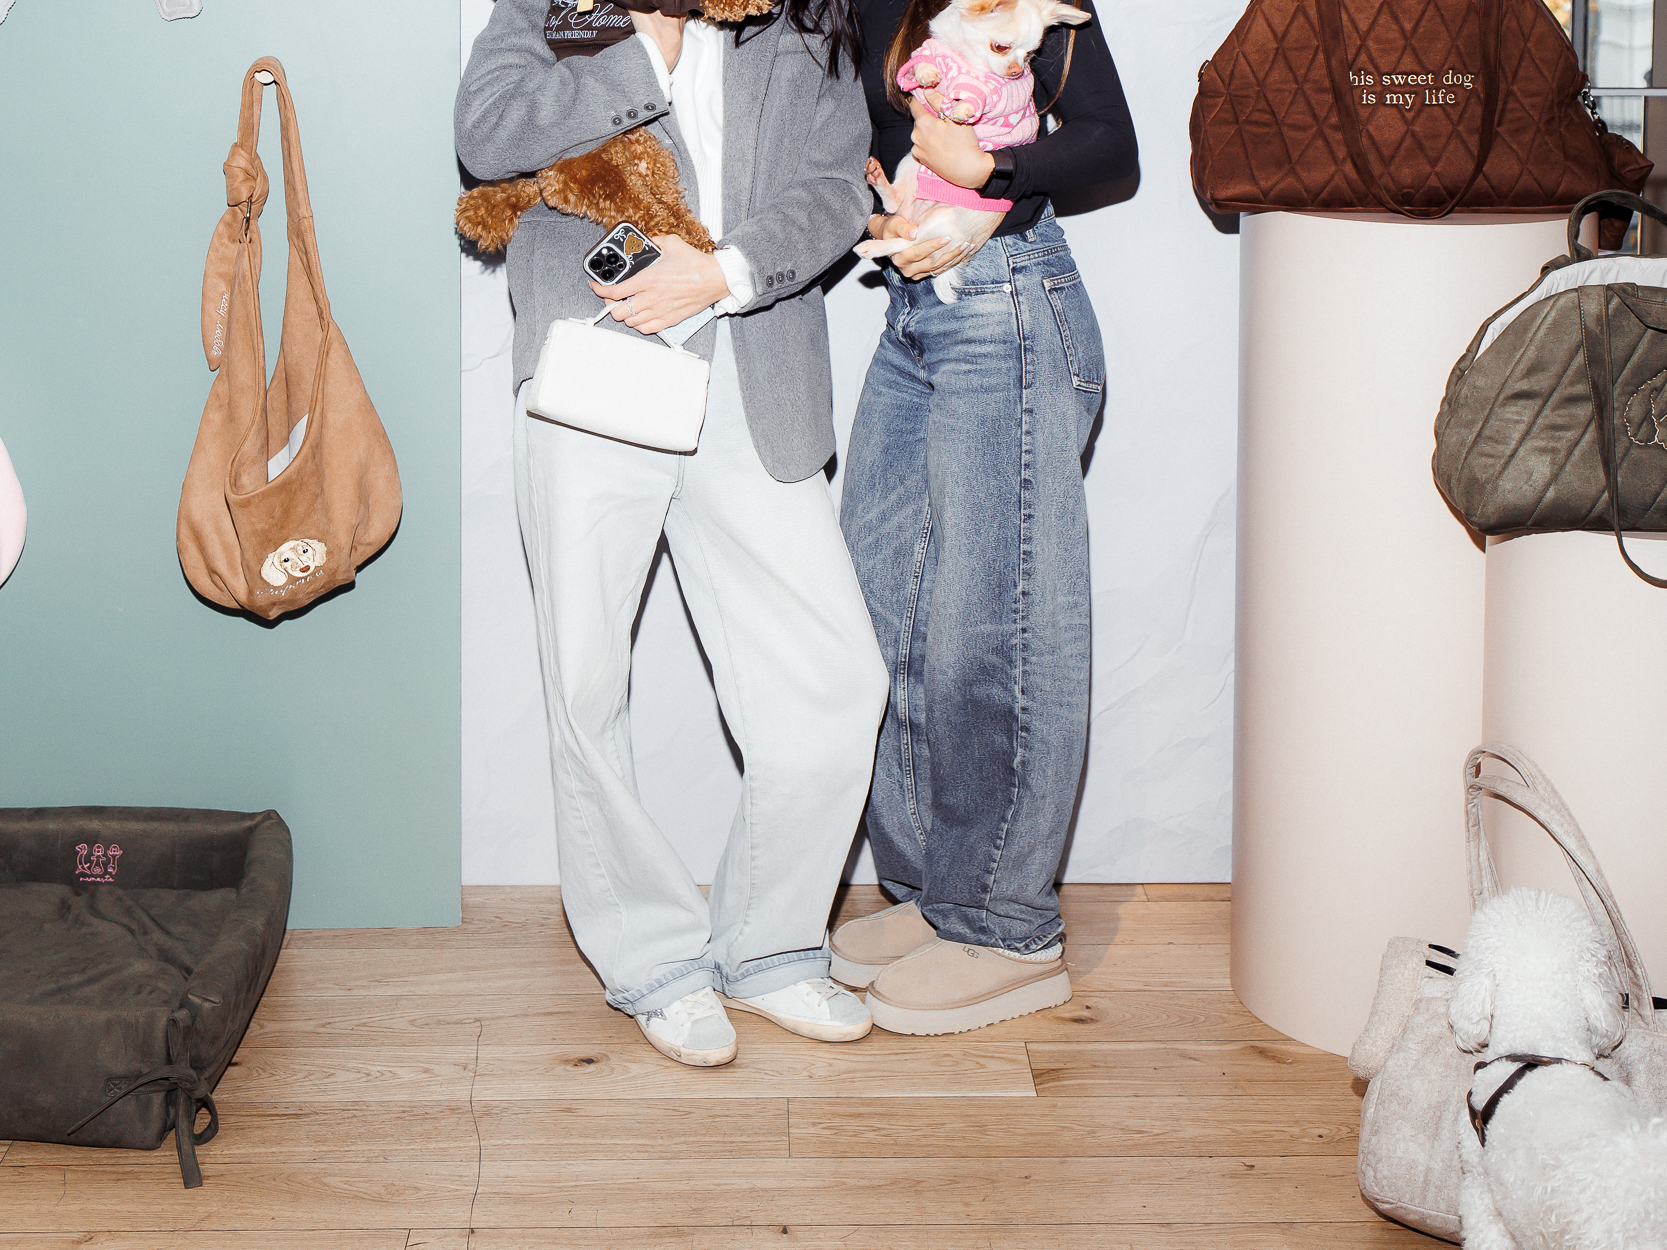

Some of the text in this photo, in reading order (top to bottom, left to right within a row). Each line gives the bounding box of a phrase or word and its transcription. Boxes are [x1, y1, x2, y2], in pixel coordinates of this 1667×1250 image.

[568, 2, 632, 29] Home
[564, 30, 598, 39] FRIENDLY
[1349, 70, 1474, 89] his sweet dog
[1361, 89, 1456, 109] is my life
[962, 945, 980, 959] UGG
